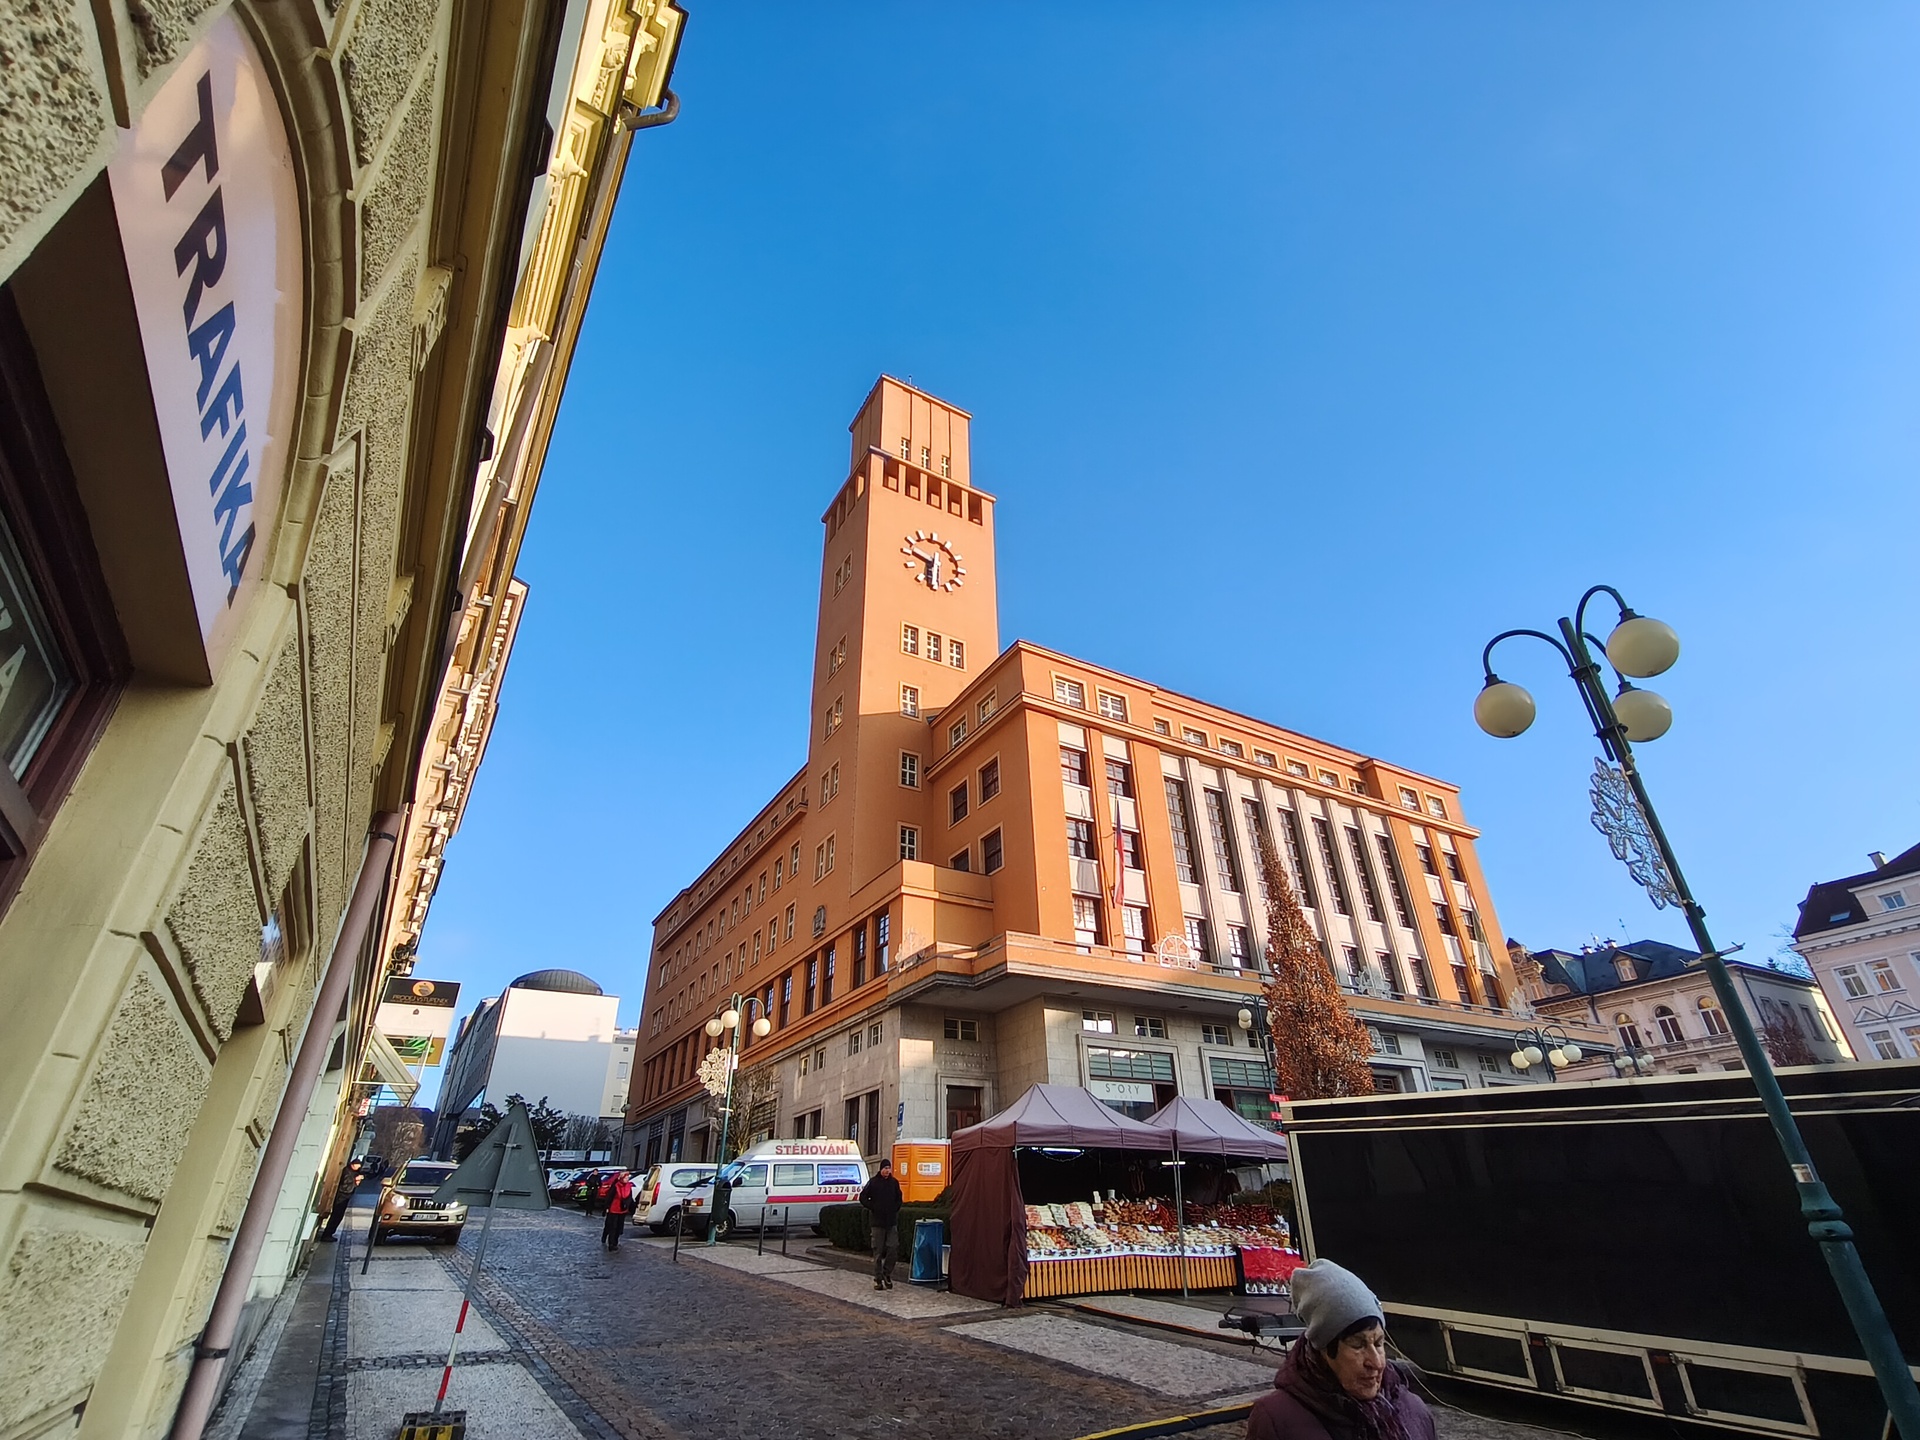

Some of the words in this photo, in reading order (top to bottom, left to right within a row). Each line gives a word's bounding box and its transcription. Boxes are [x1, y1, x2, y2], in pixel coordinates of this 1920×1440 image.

[161, 69, 256, 609] TRAFIKA
[1105, 1083, 1140, 1094] STORY
[775, 1143, 849, 1155] STĚHOVÁNÍ
